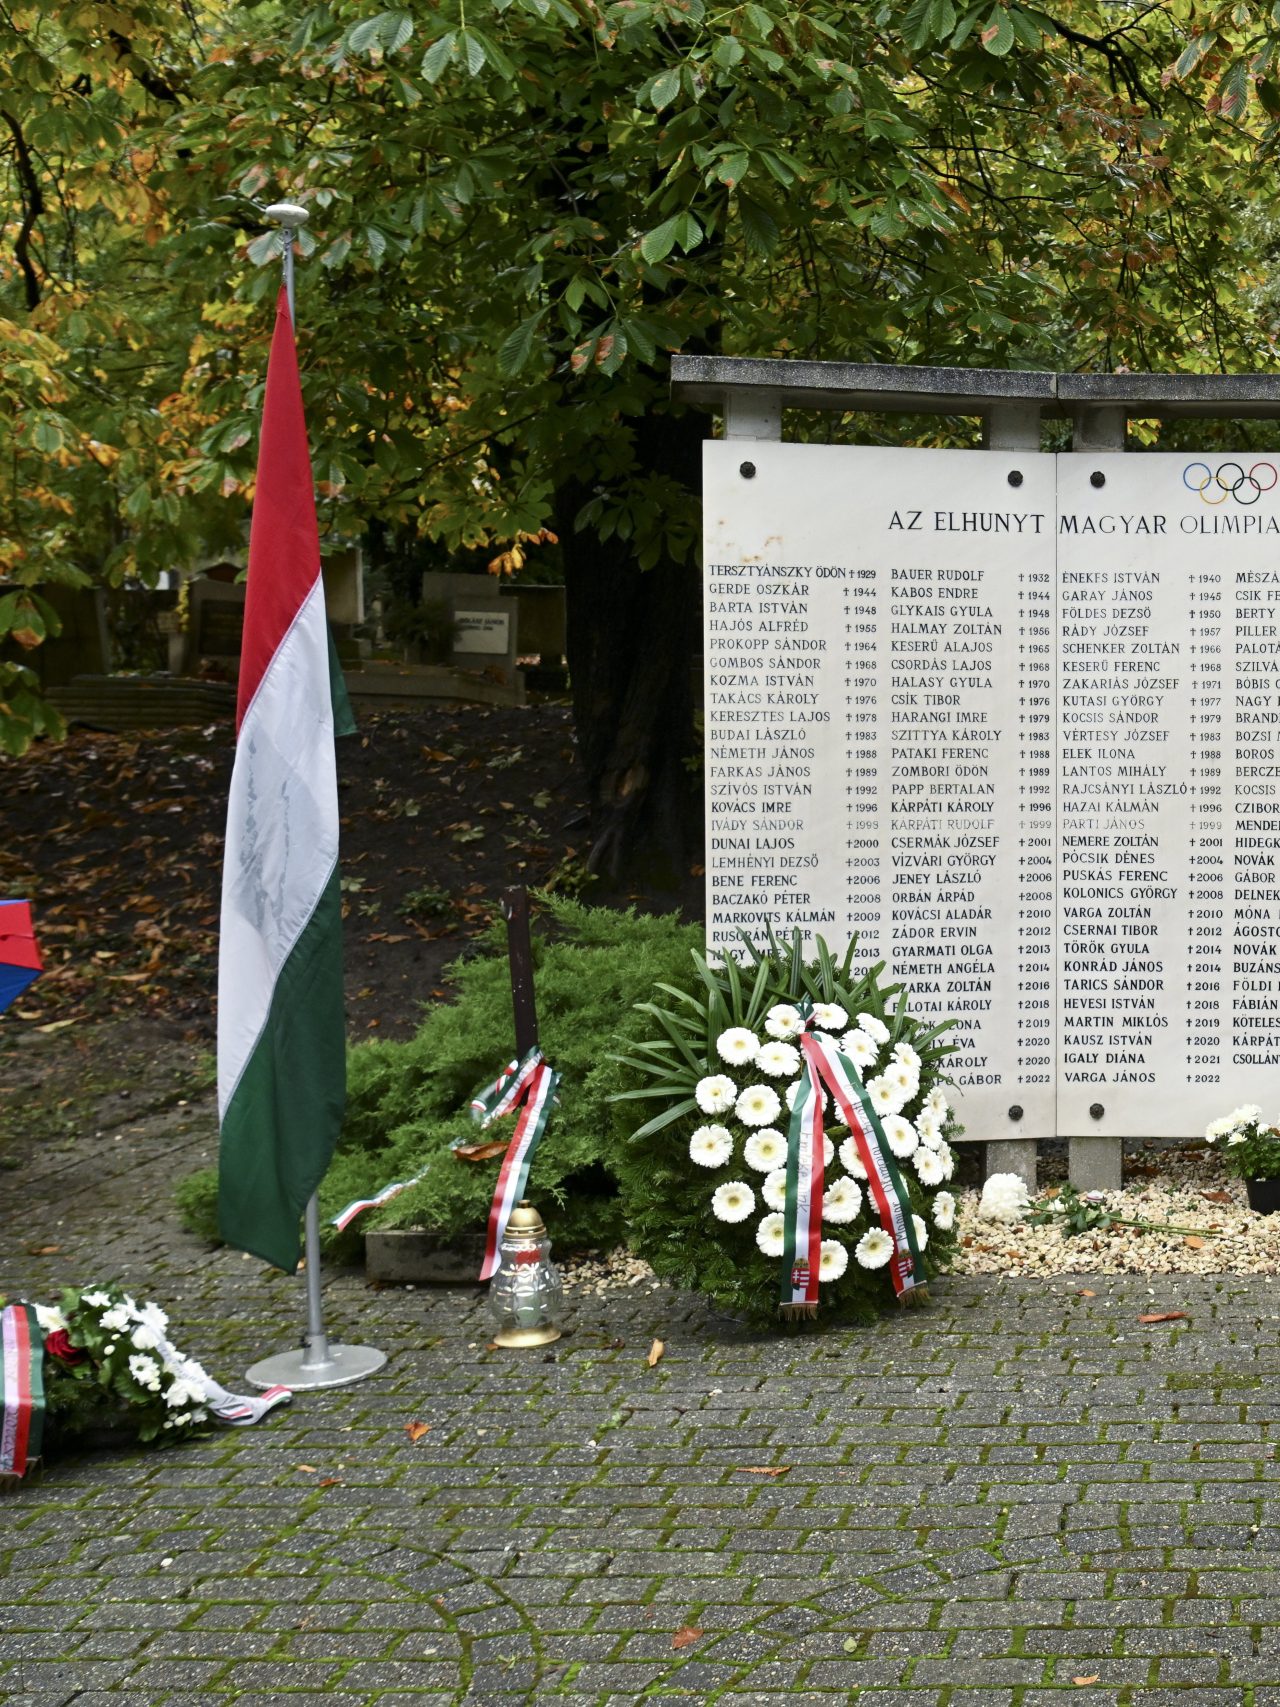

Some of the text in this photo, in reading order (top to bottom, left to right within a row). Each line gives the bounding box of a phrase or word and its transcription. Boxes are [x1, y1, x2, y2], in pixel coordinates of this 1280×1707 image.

[887, 510, 923, 531] AZ
[933, 511, 1046, 534] ELHUNYT
[1058, 514, 1168, 535] MAGYAR
[890, 568, 985, 582] BAUER RUDOLF
[708, 582, 751, 595] GERDE
[1062, 590, 1106, 602] GARAY
[709, 601, 753, 614] BARTA
[890, 604, 945, 617] GLYKAIS
[949, 605, 993, 618] GYULA
[1235, 608, 1276, 619] BERTY
[891, 622, 948, 635] HALMAY
[1235, 625, 1278, 637] PILLER
[1062, 642, 1126, 654] SCHENKER
[709, 656, 764, 669] GOMBOS
[952, 659, 992, 672] LAJOS
[923, 694, 961, 706] TIBOR
[1062, 712, 1104, 724] KOCSIS
[710, 729, 750, 741] BUDAI
[891, 729, 948, 741] SZITTYA
[1062, 748, 1093, 760] ELEK
[1098, 748, 1136, 760] ILONA
[1235, 748, 1275, 760] BOROS
[710, 766, 763, 778] FARKAS
[892, 783, 995, 795] PAPP BERTALAN
[1234, 784, 1276, 796] KOCSIS
[761, 801, 792, 814] IMRE
[1234, 802, 1280, 814] CZIBOR
[1062, 835, 1110, 847] NEMERE
[712, 874, 798, 887] BENE FERENC
[892, 873, 931, 885] JENEY
[1118, 870, 1168, 882] FERENC
[1063, 906, 1103, 918] VARGA
[892, 944, 994, 958] GYARMATI OLGA
[1110, 943, 1150, 954] GYULA
[1063, 978, 1108, 991] TARICS
[1064, 1016, 1114, 1028] MARTIN
[1064, 1052, 1100, 1064] IGALY
[1064, 1072, 1107, 1083] VARGA
